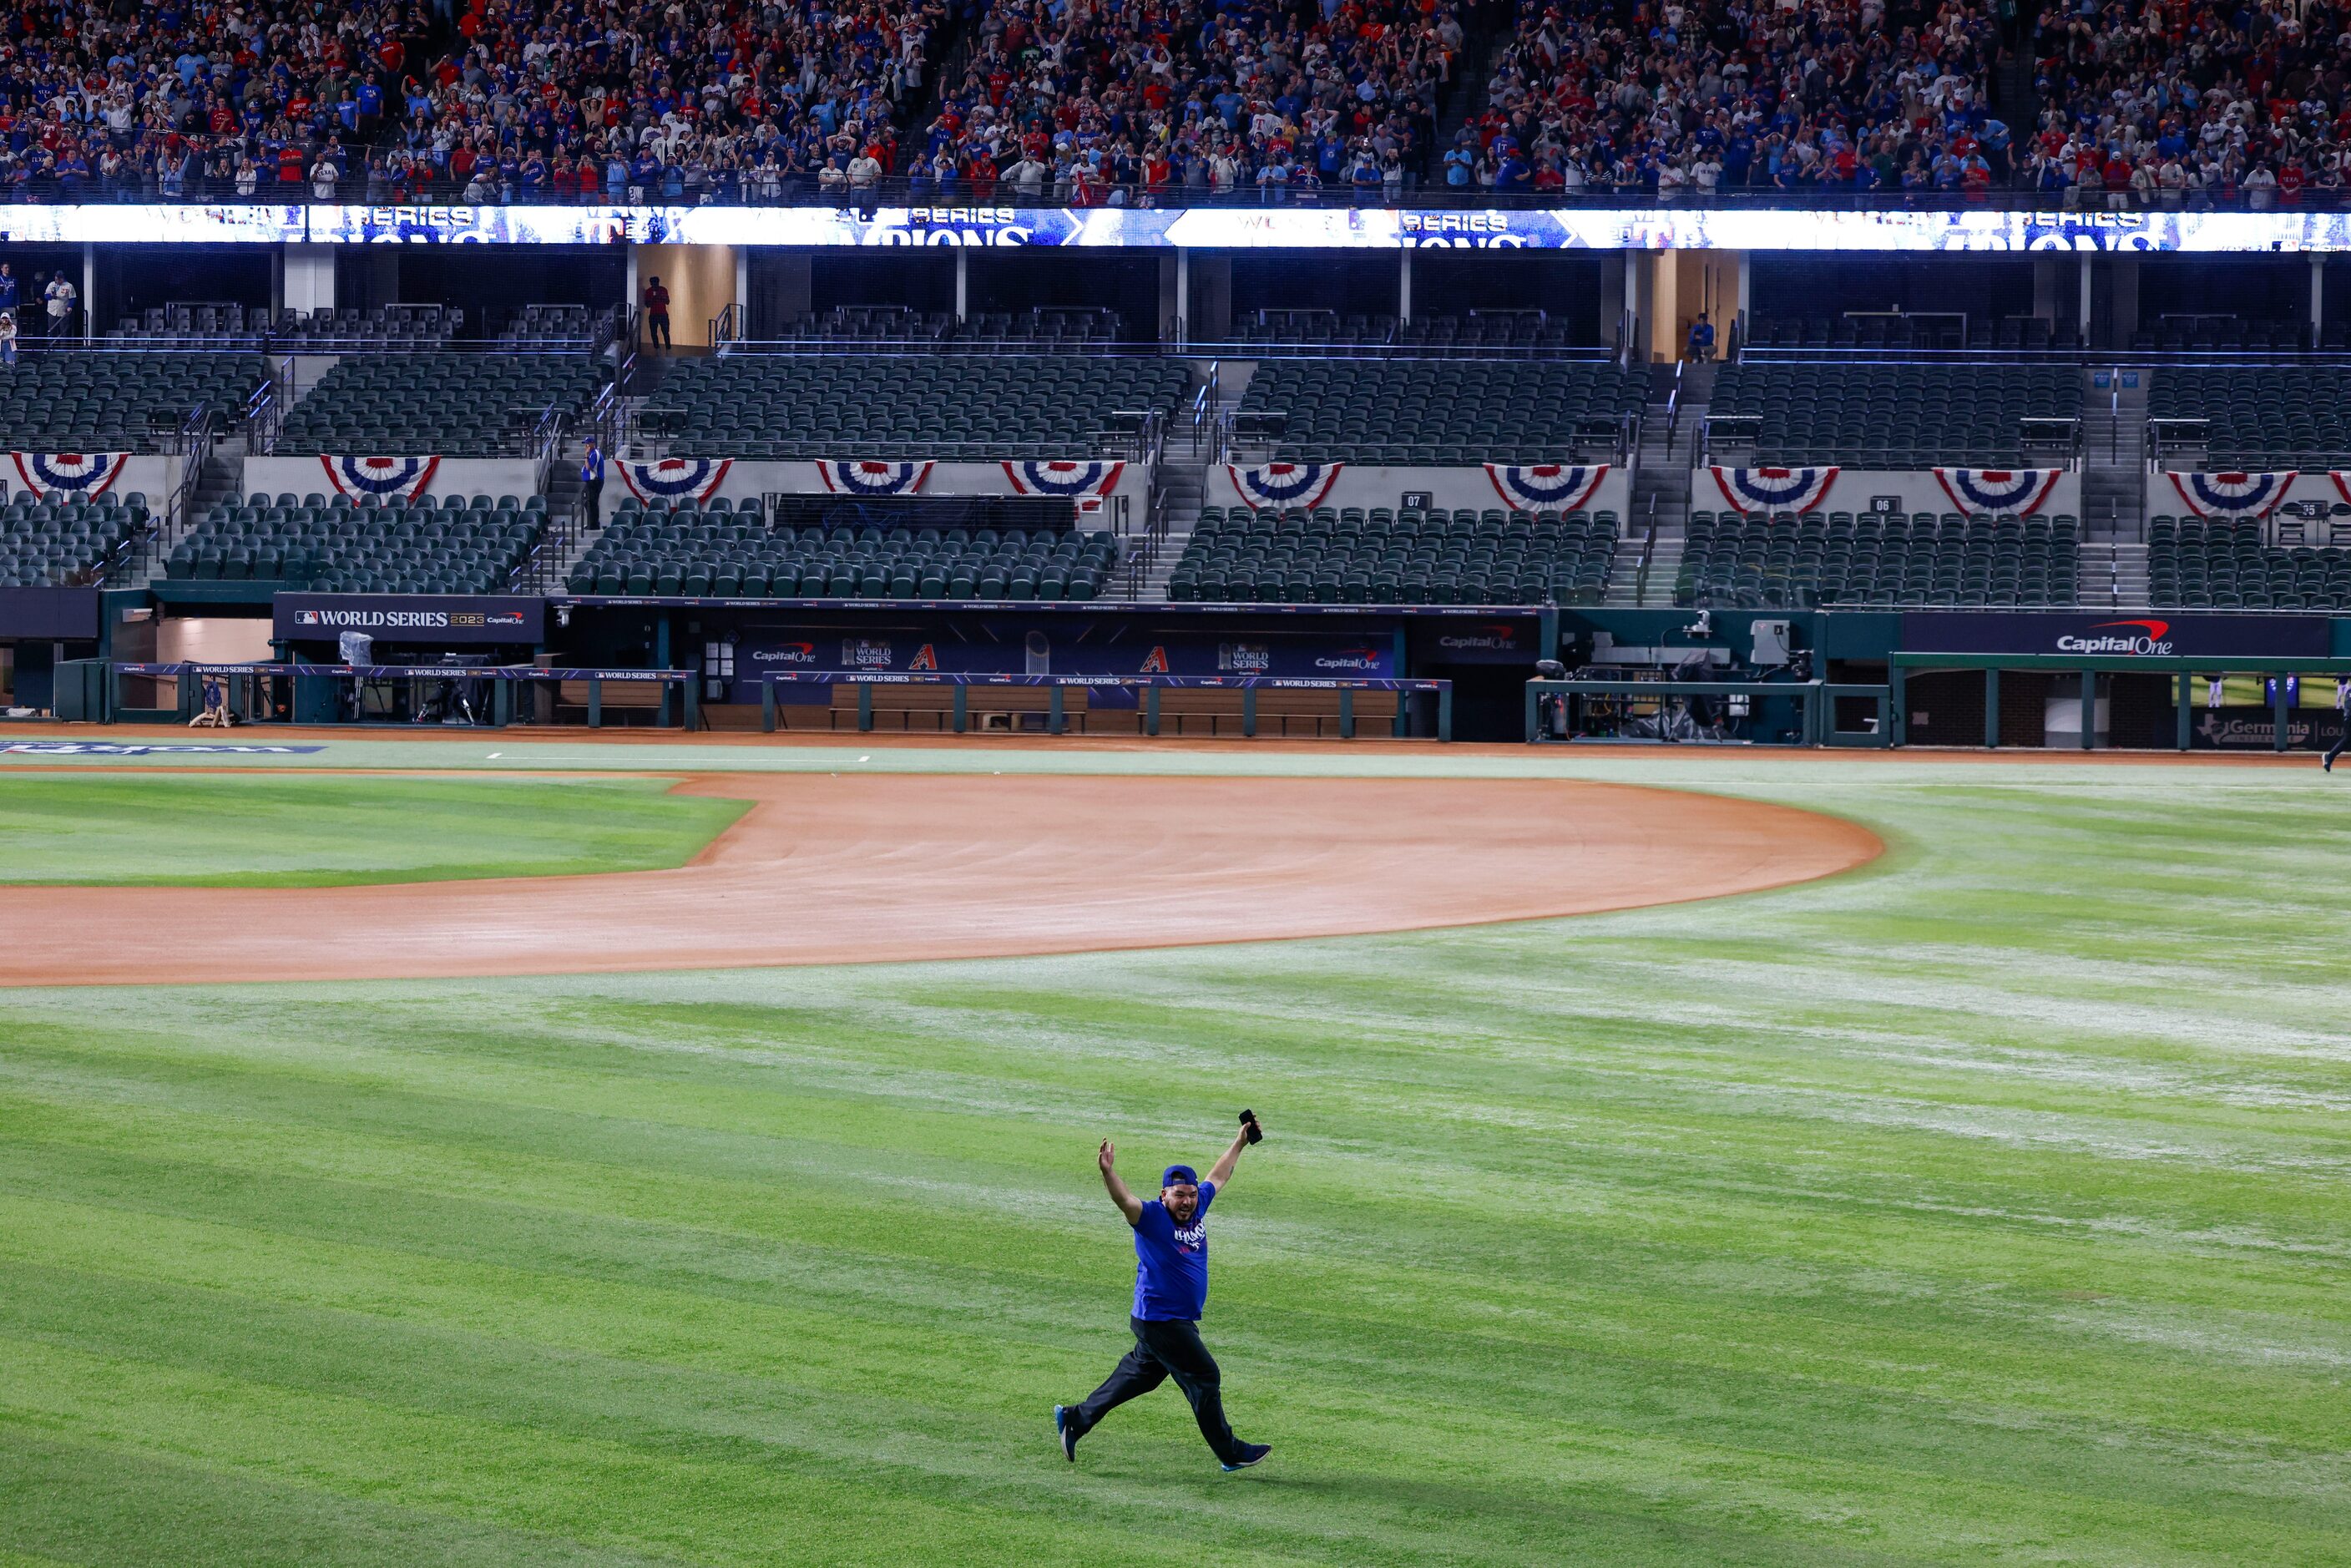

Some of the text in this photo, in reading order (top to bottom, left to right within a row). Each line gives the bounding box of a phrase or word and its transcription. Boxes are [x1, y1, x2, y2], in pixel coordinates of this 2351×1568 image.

[912, 208, 1015, 224] SERIES
[1402, 215, 1509, 231] SERIES
[1408, 496, 1420, 507] 07
[1877, 500, 1889, 511] 06
[320, 611, 385, 626] WORLD
[387, 611, 447, 627] SERIES
[450, 615, 484, 625] 2023
[856, 648, 891, 656] WORLD
[1233, 652, 1269, 660] WORLD
[856, 655, 891, 665] SERIES
[1233, 660, 1269, 669] SERIES
[2230, 720, 2310, 735] Germnia
